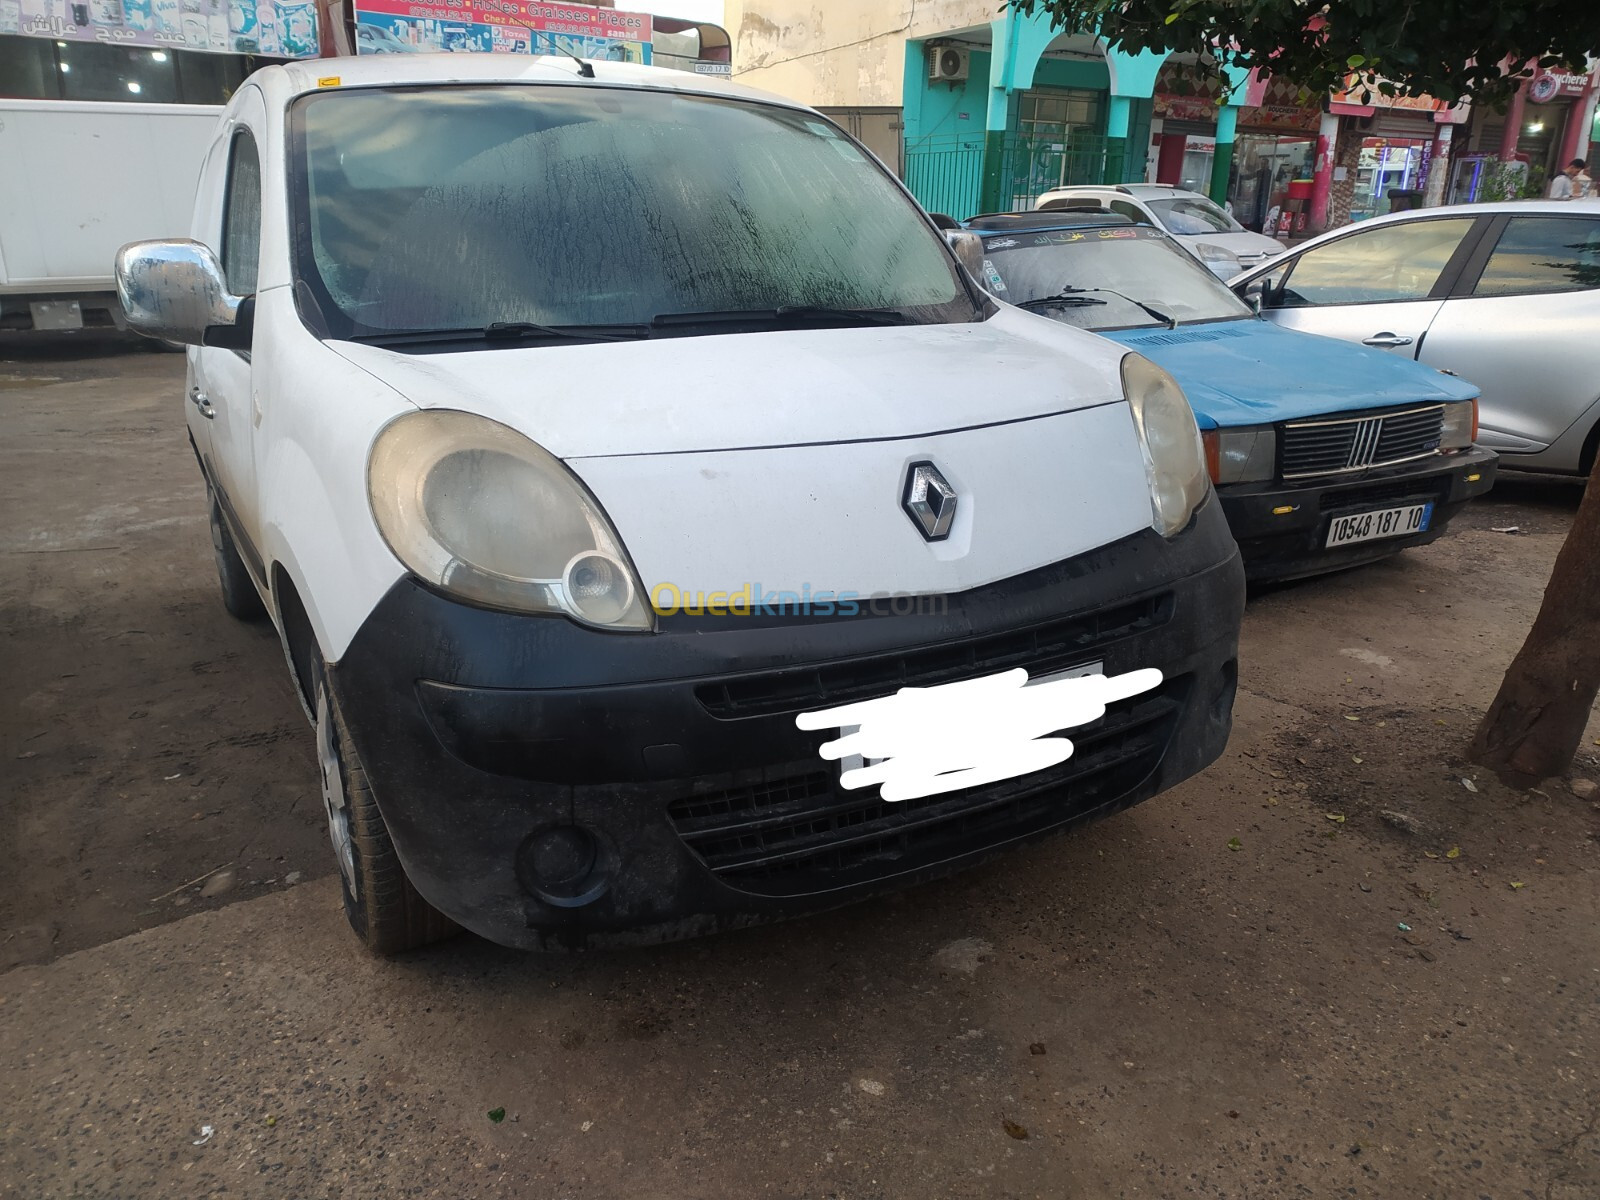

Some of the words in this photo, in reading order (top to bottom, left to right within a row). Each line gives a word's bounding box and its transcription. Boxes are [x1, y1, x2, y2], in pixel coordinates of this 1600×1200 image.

[483, 13, 506, 25] Chez
[528, 3, 589, 22] Graisses
[598, 12, 642, 28] Pièces
[503, 30, 530, 40] TOTAL
[607, 29, 638, 40] sanad
[1331, 514, 1373, 542] 10548
[1376, 510, 1402, 535] 187
[1406, 507, 1424, 530] 10
